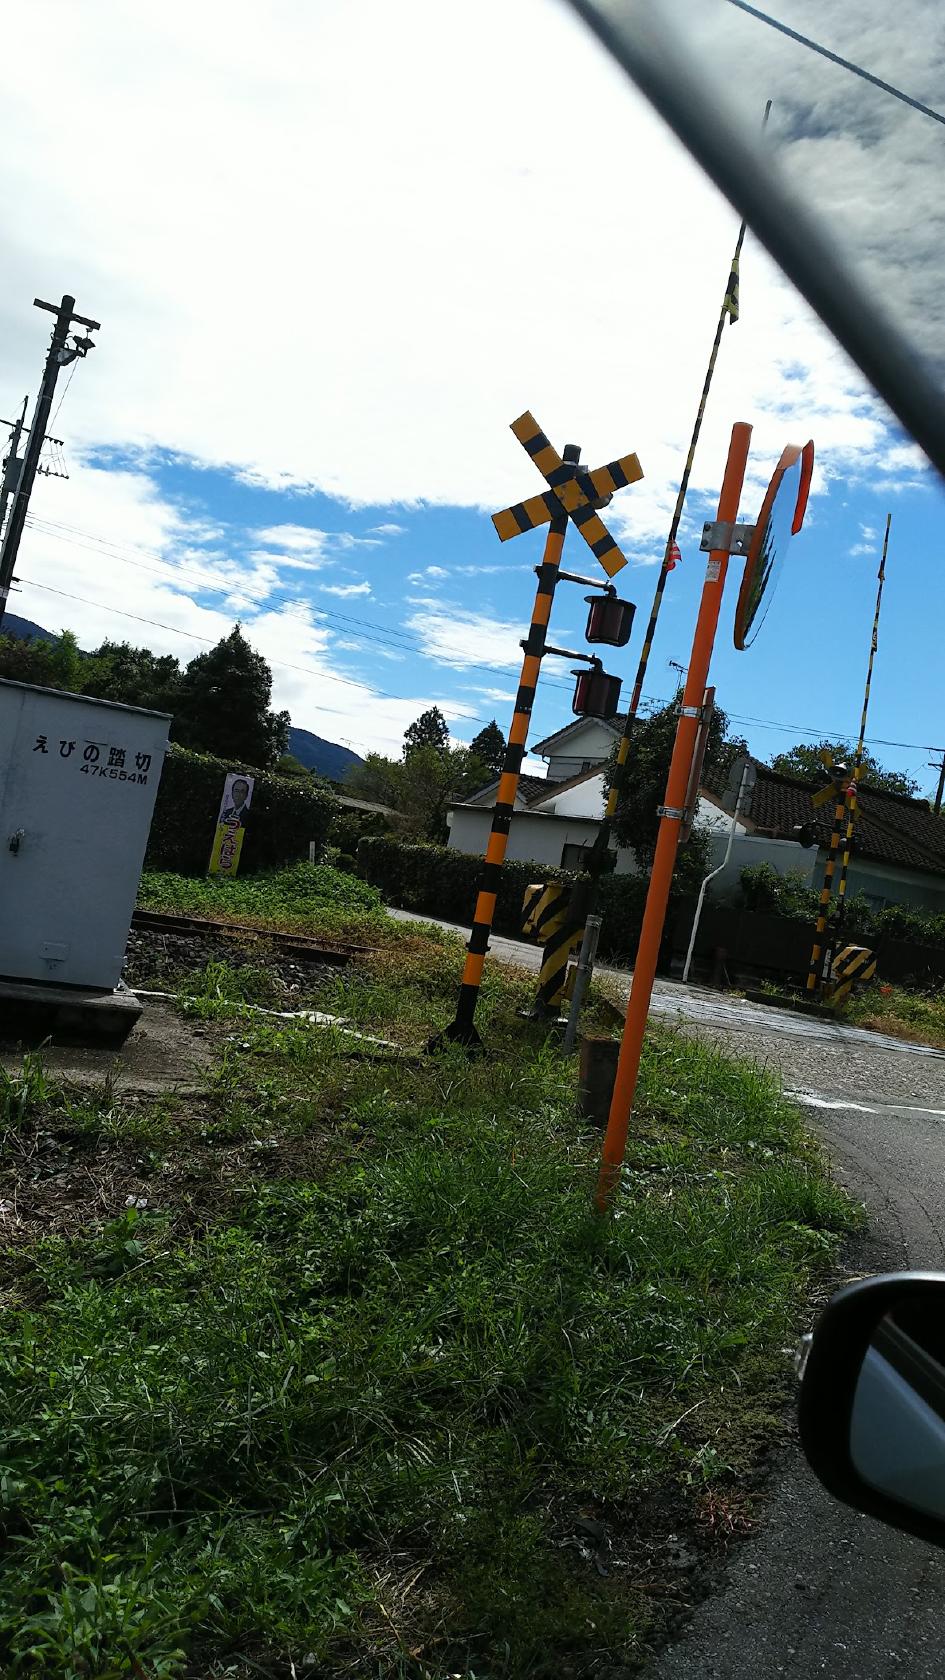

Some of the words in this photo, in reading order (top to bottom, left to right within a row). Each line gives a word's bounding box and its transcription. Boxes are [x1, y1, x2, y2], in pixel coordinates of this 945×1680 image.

[32, 735, 152, 772] えびの踏切
[79, 764, 148, 785] 47K554M
